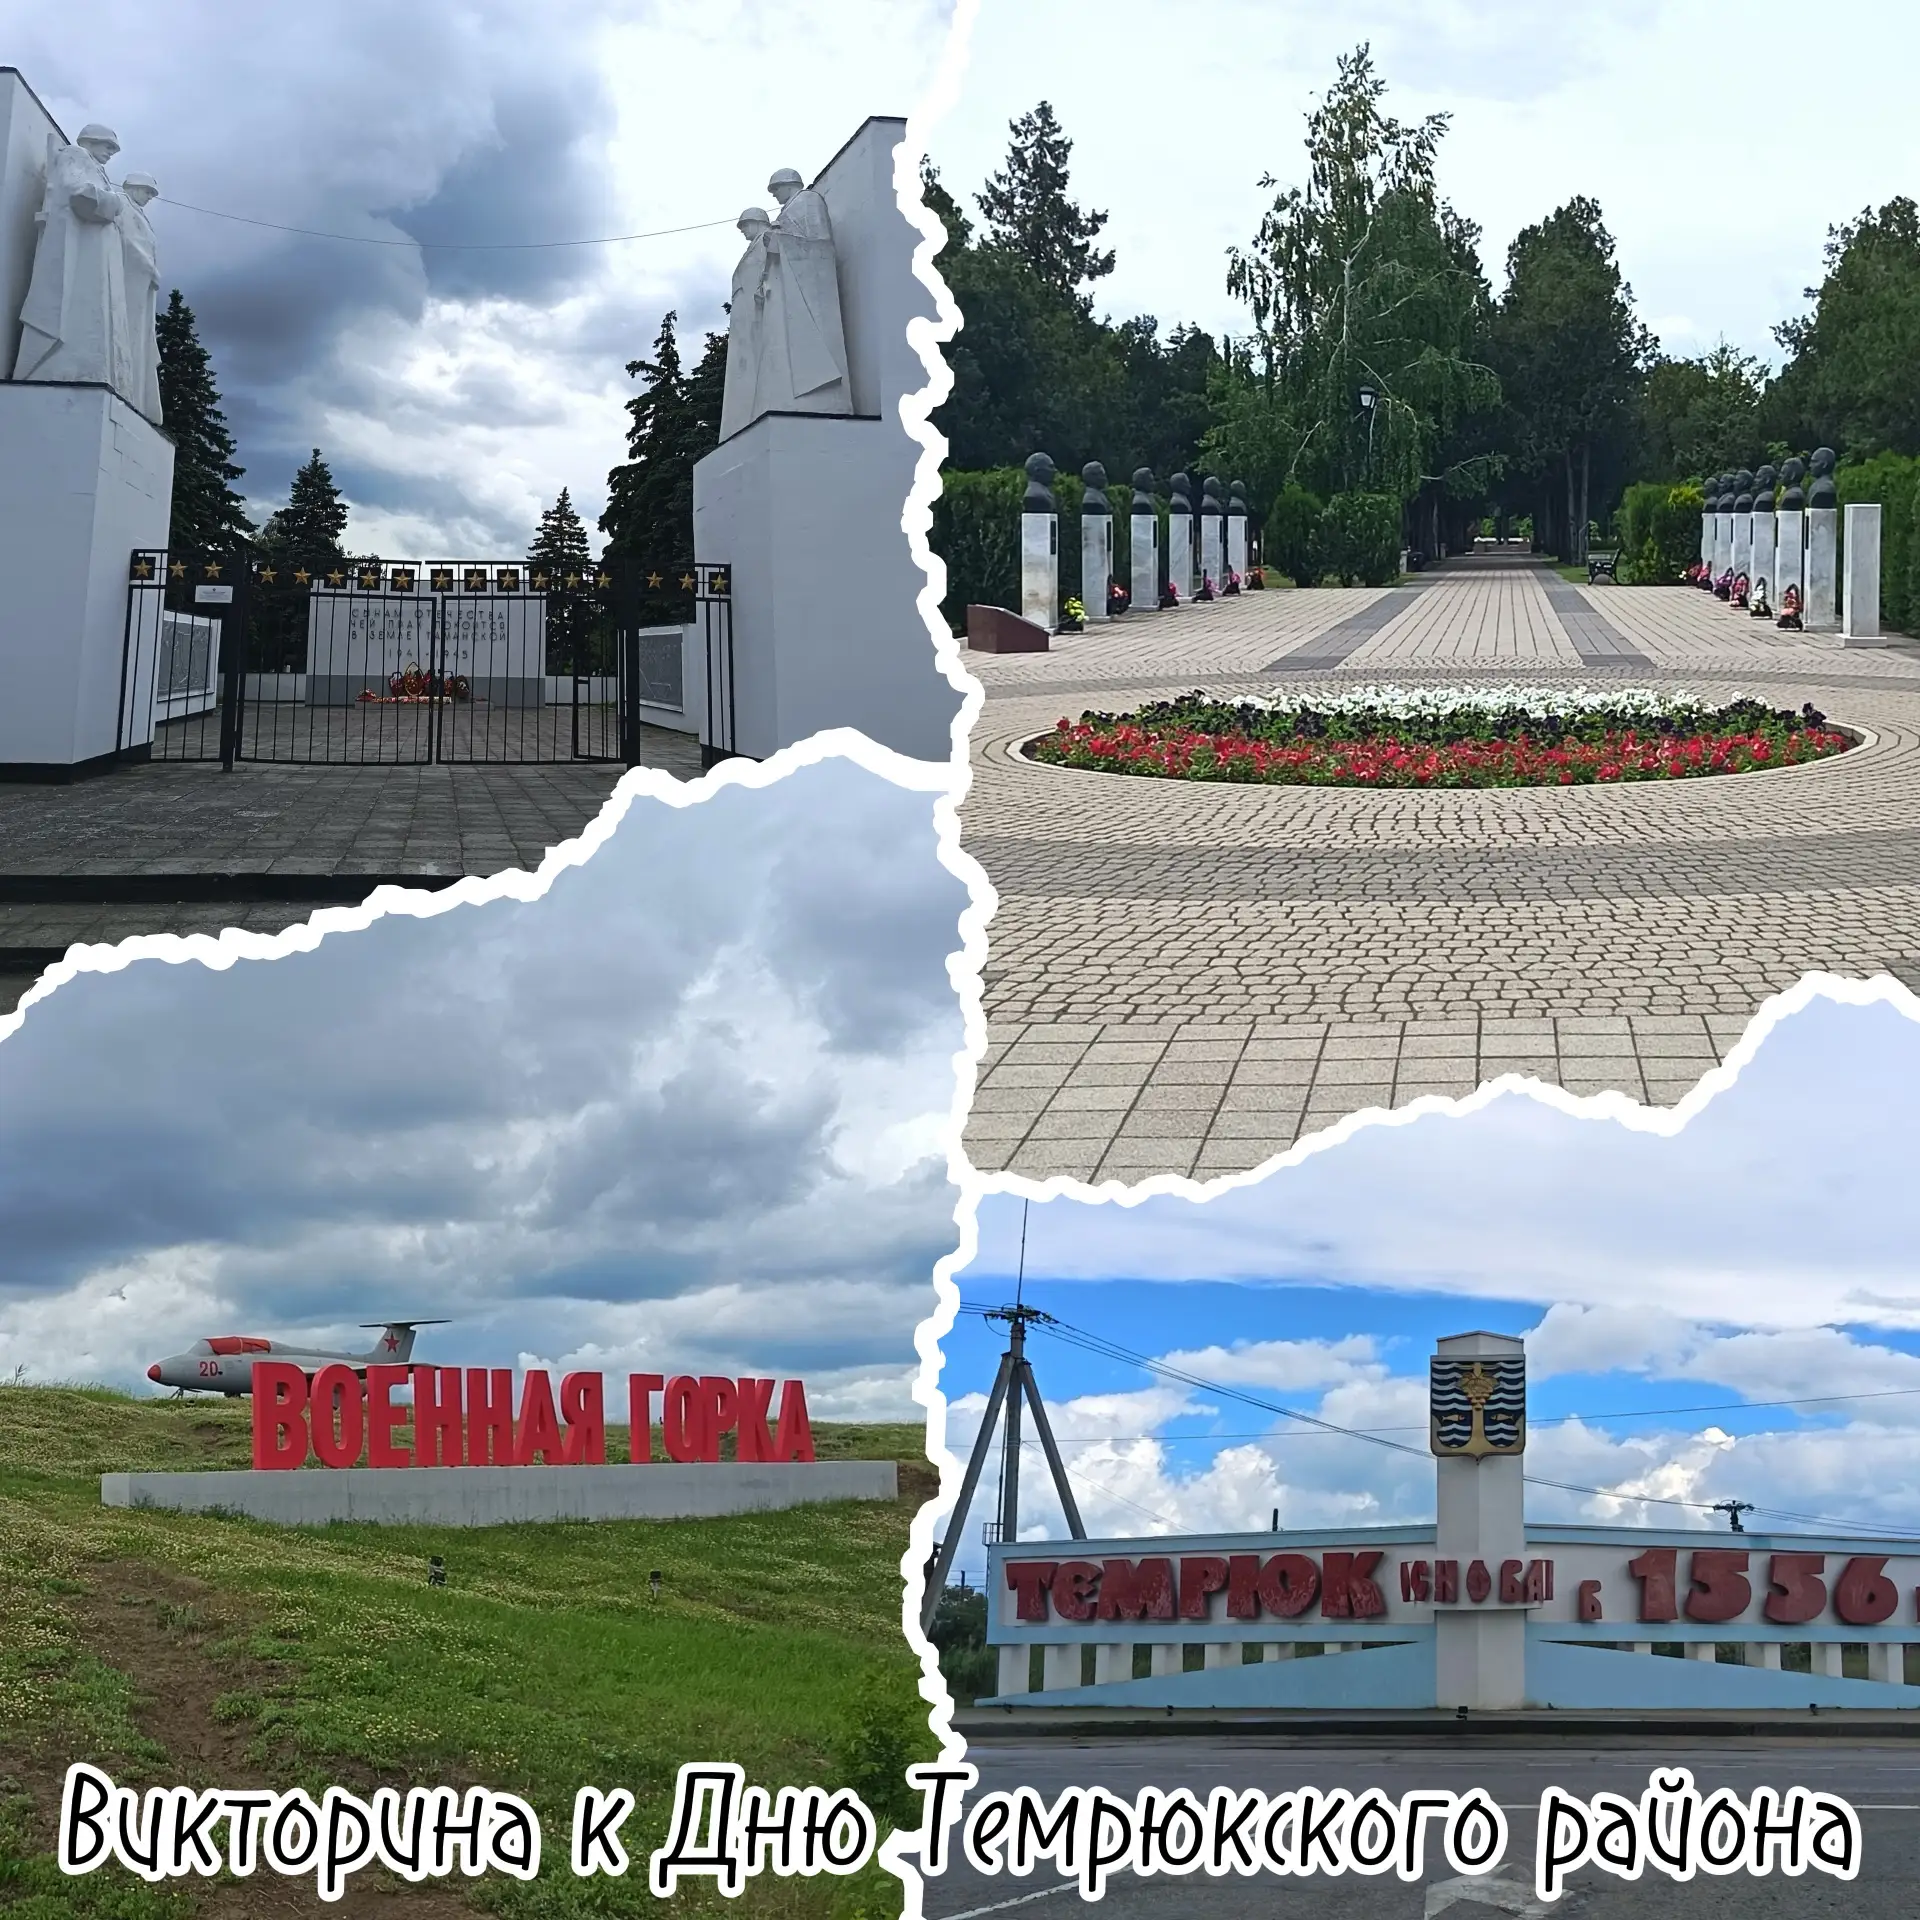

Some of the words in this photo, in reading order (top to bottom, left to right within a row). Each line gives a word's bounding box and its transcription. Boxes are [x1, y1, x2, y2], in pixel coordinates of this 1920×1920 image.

[199, 1360, 219, 1377] 20
[252, 1362, 605, 1470] ВОЕННАЯ
[629, 1373, 816, 1464] ГОРКА
[1628, 1549, 1899, 1625] 1556
